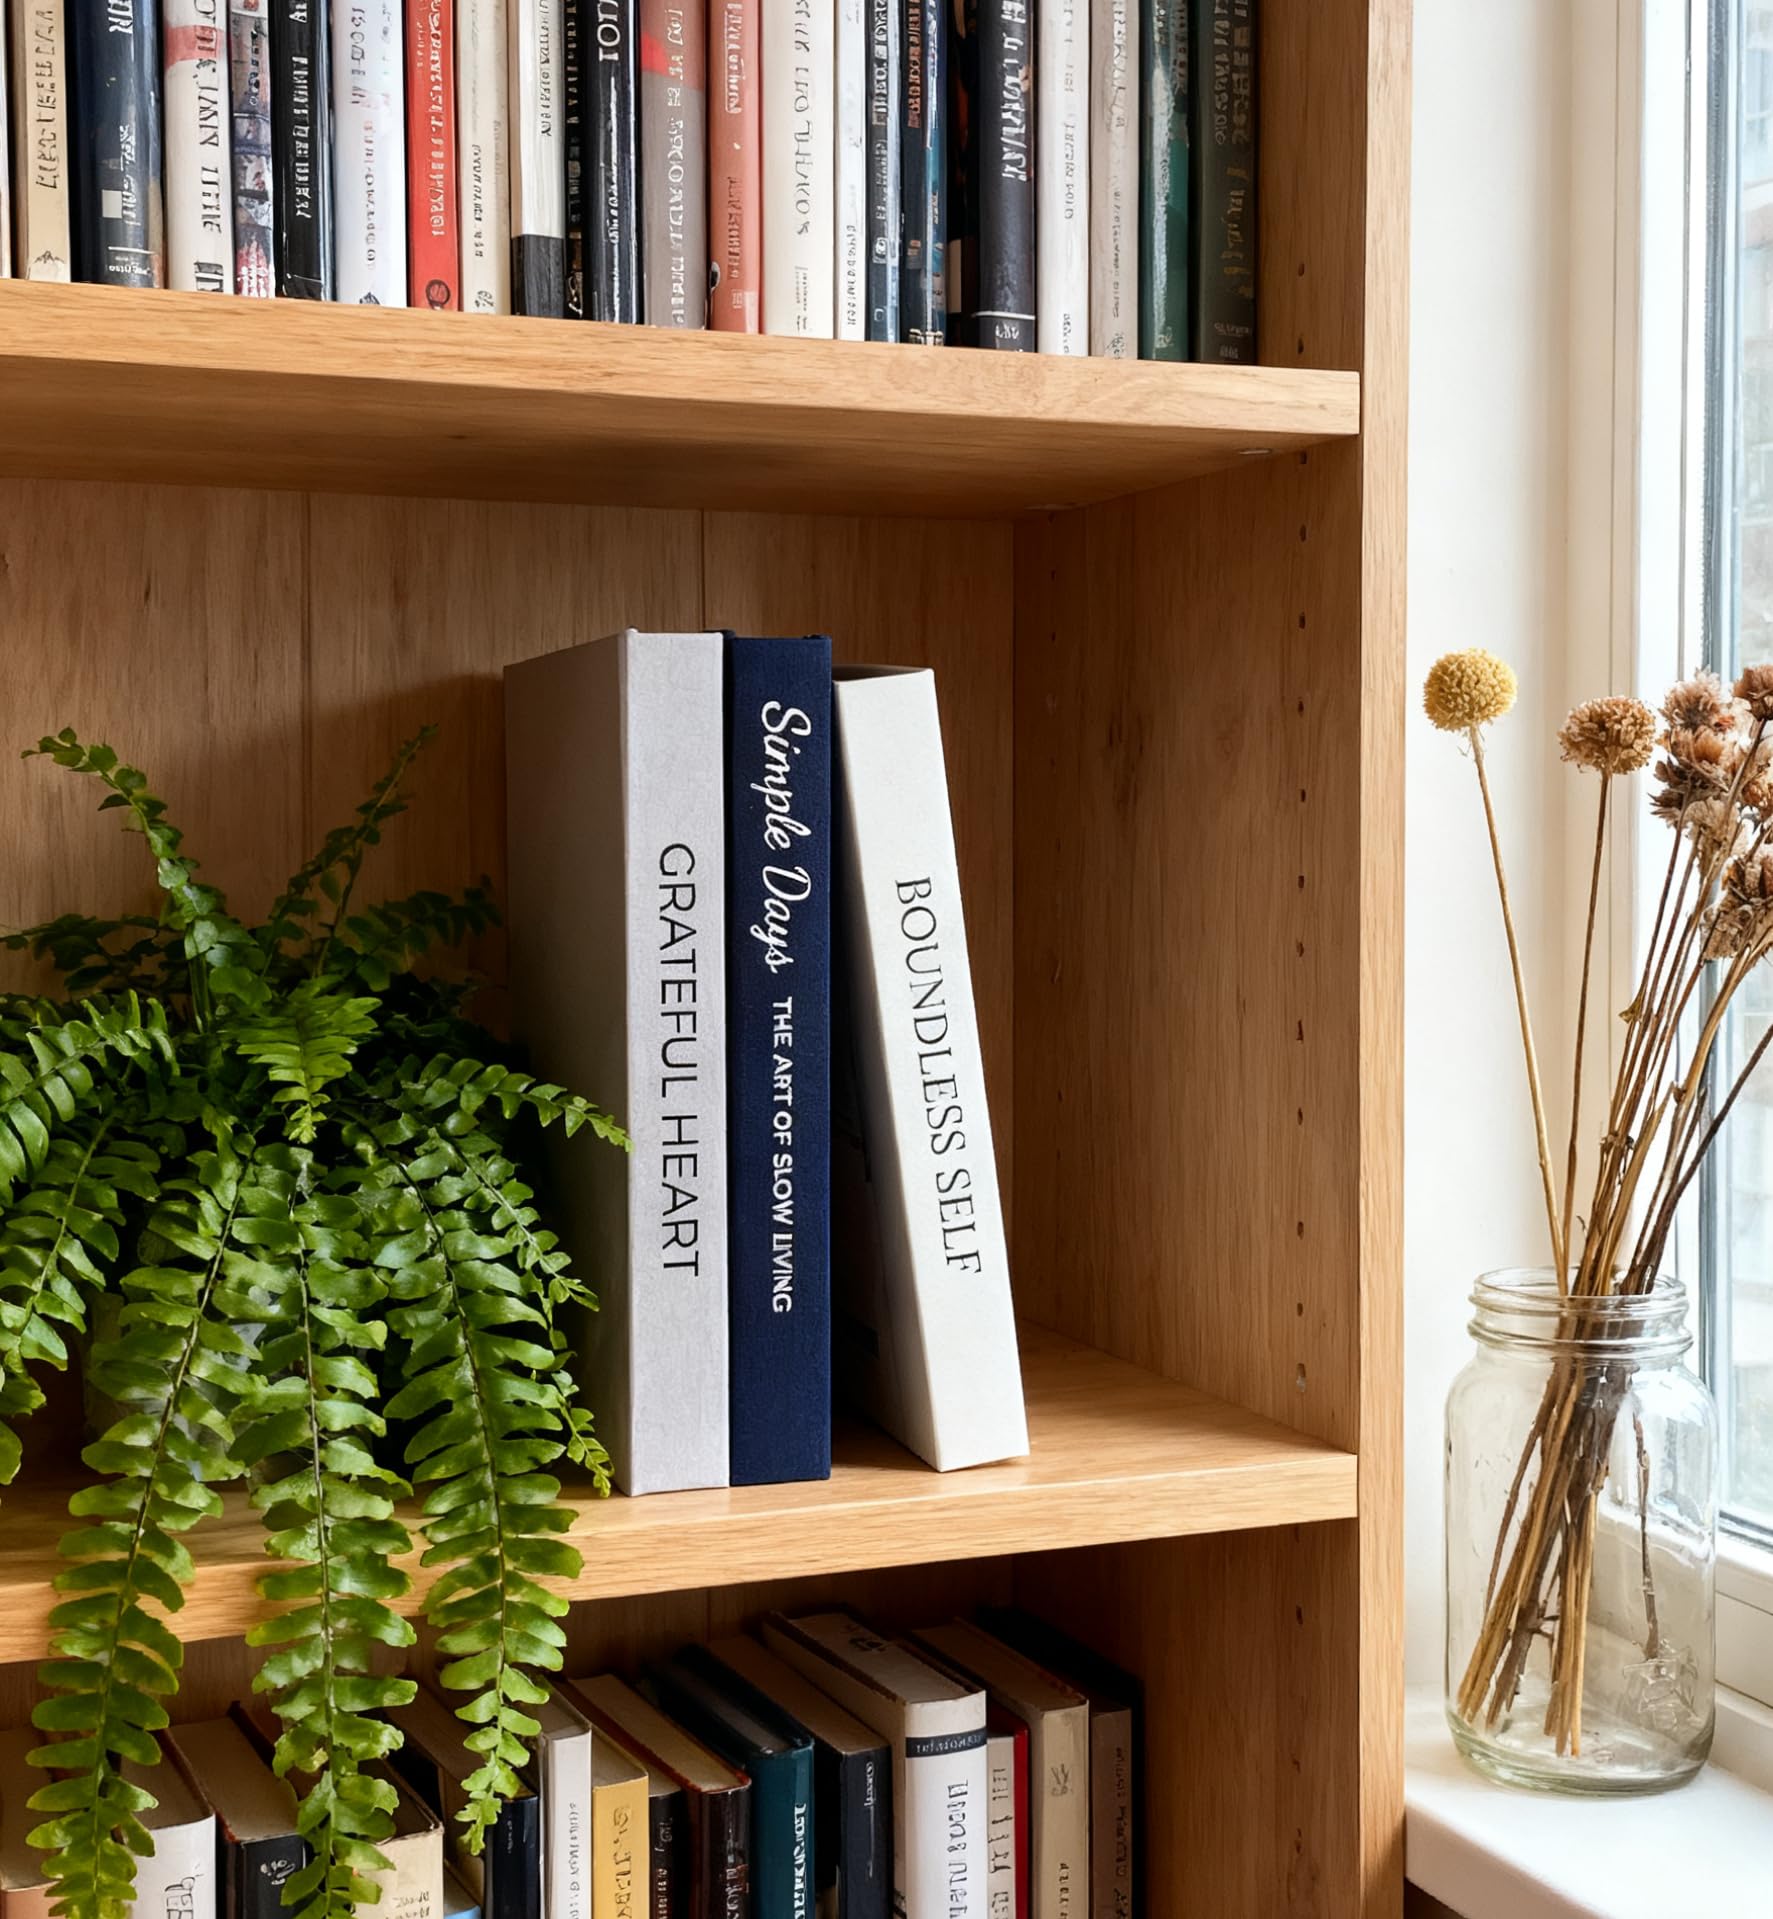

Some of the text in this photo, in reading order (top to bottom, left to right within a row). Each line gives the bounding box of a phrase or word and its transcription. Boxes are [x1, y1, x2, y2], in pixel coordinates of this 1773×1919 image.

[750, 700, 812, 974] Simple Days
[658, 843, 700, 1277] GRATEFUL HEART
[772, 996, 794, 1313] THE ART OF SLOW LIVING
[895, 877, 982, 1273] BOUNDLESS SELF
